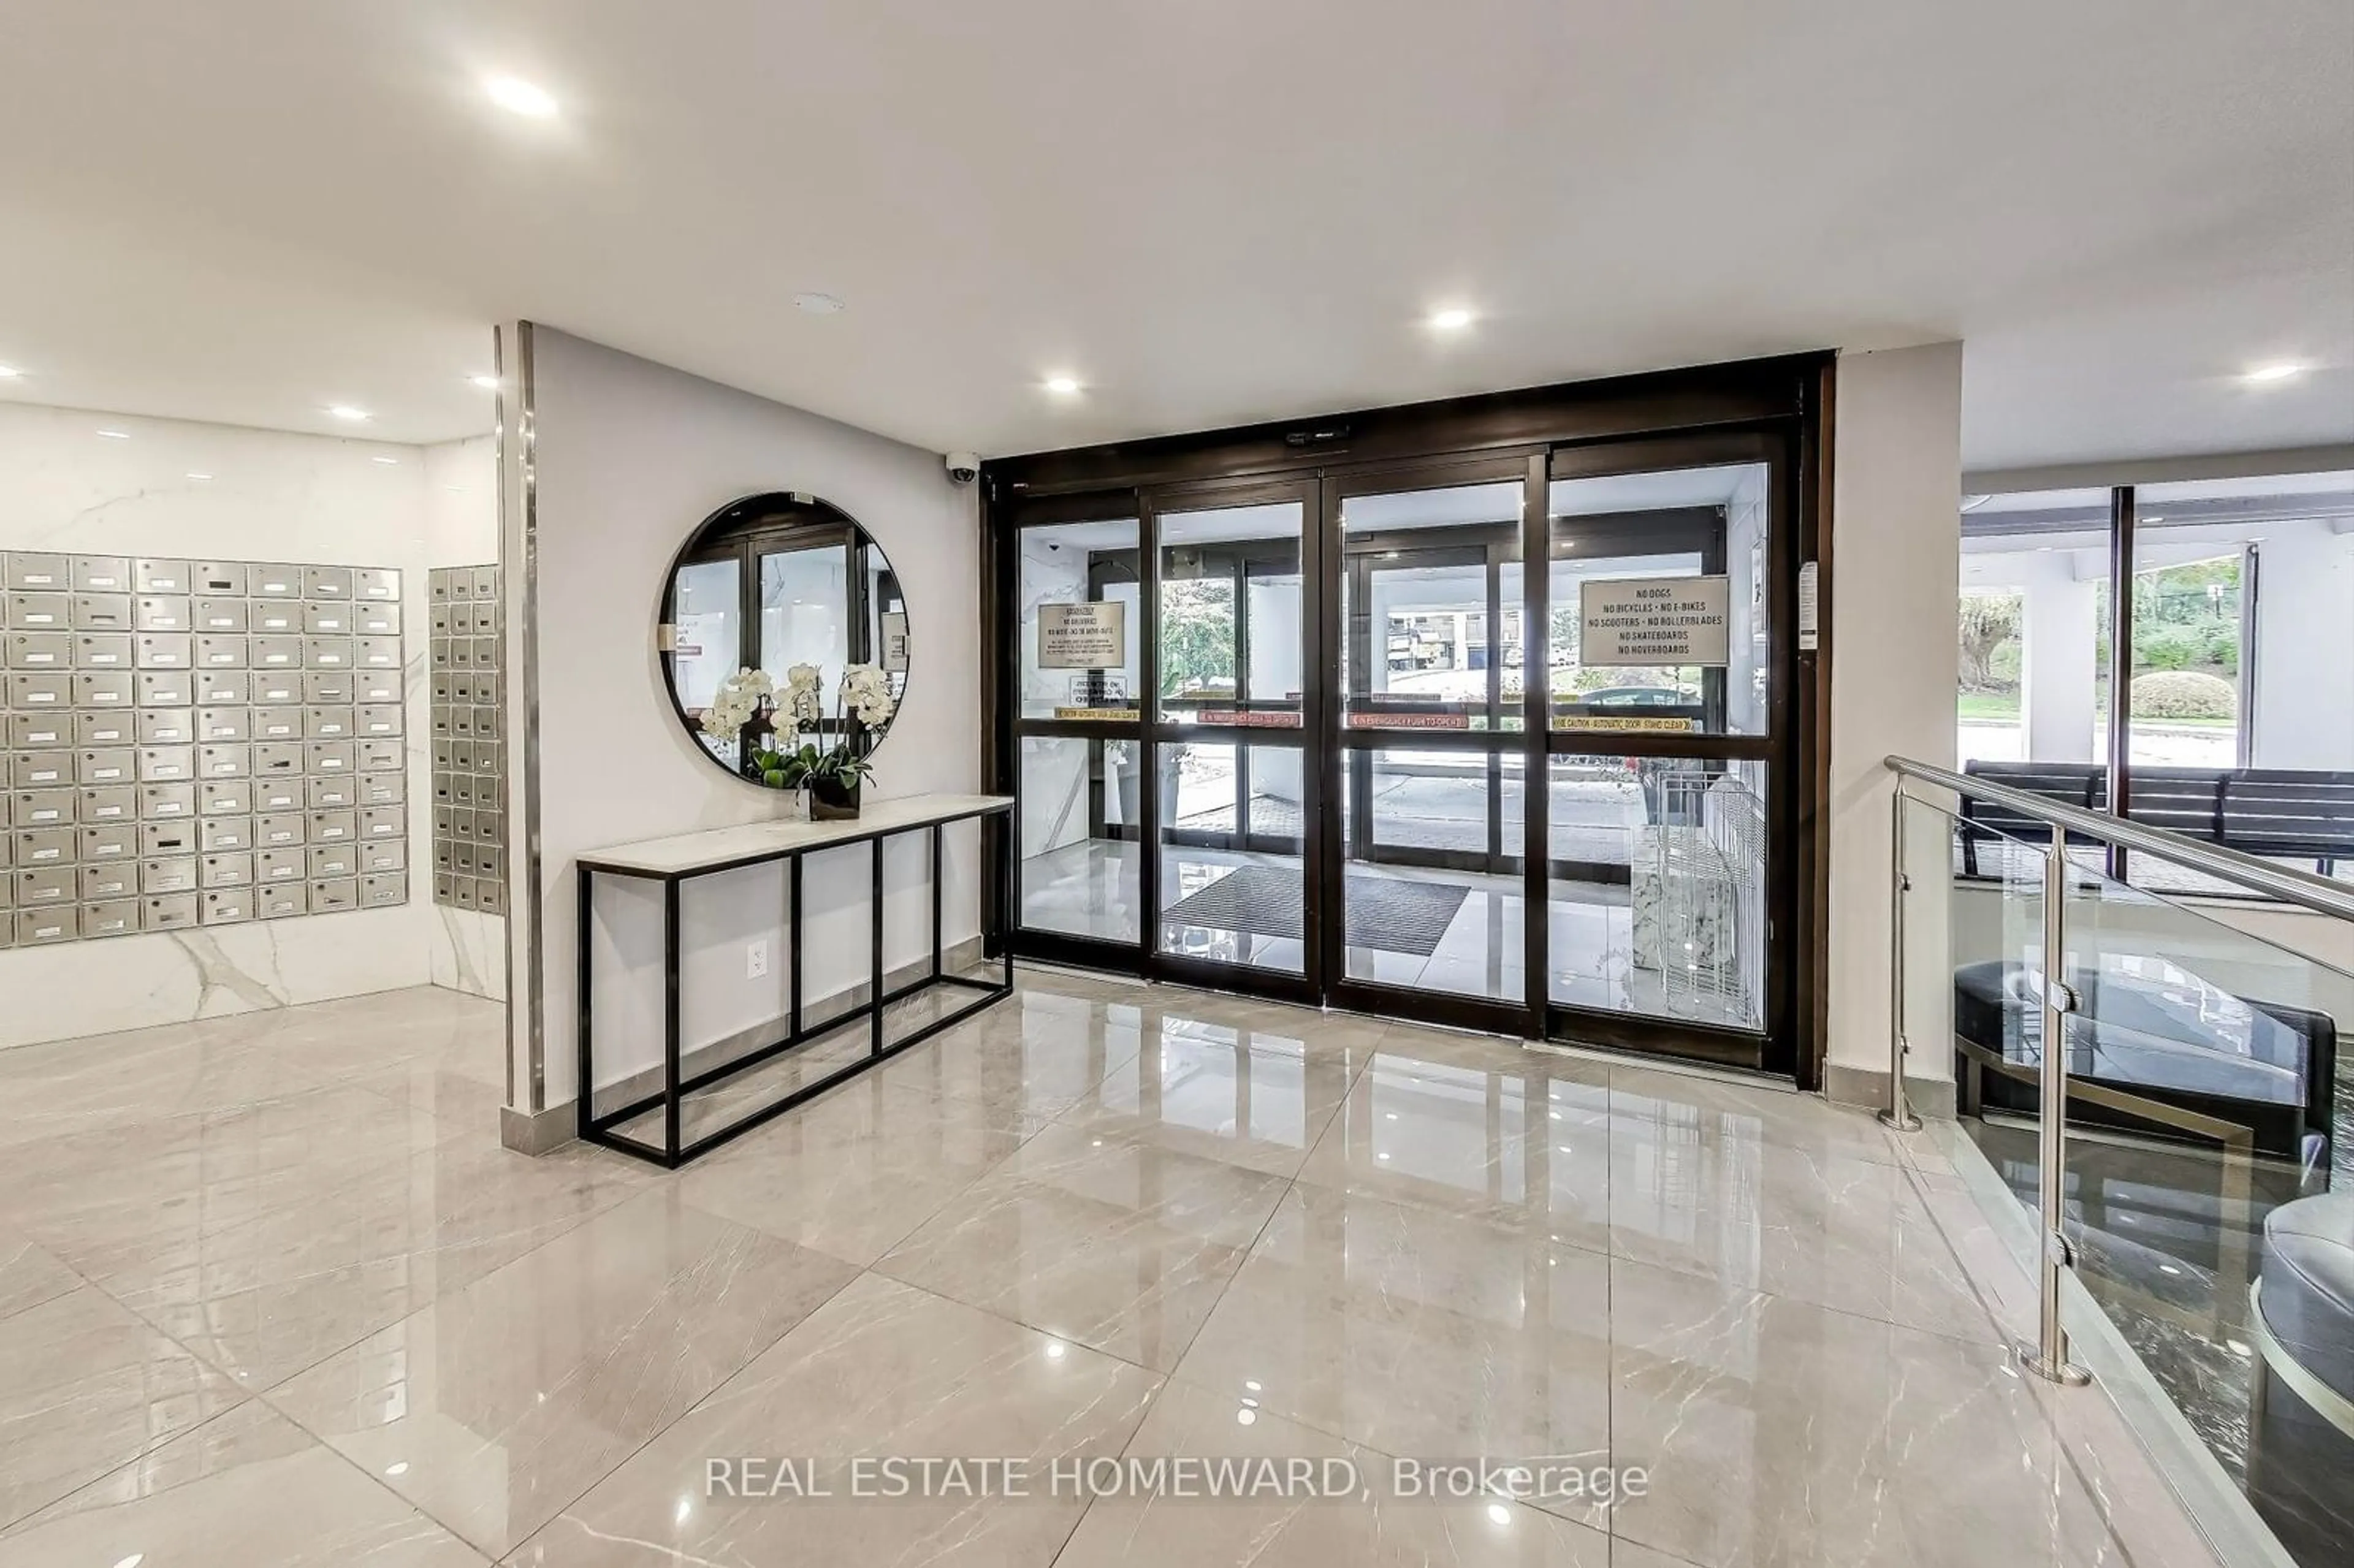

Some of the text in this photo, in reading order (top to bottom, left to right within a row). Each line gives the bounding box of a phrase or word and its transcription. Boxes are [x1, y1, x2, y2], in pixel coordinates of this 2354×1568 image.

[1636, 588, 1672, 598] NO DOGS
[1604, 601, 1706, 613] NO BICYCLES NO E-BIKES
[1588, 615, 1723, 628] NO SCOOTERS NO ROLLERBLADES
[1620, 631, 1689, 641] NO SKATEBOARDS
[1618, 644, 1689, 655] NO HOVERBOARDS
